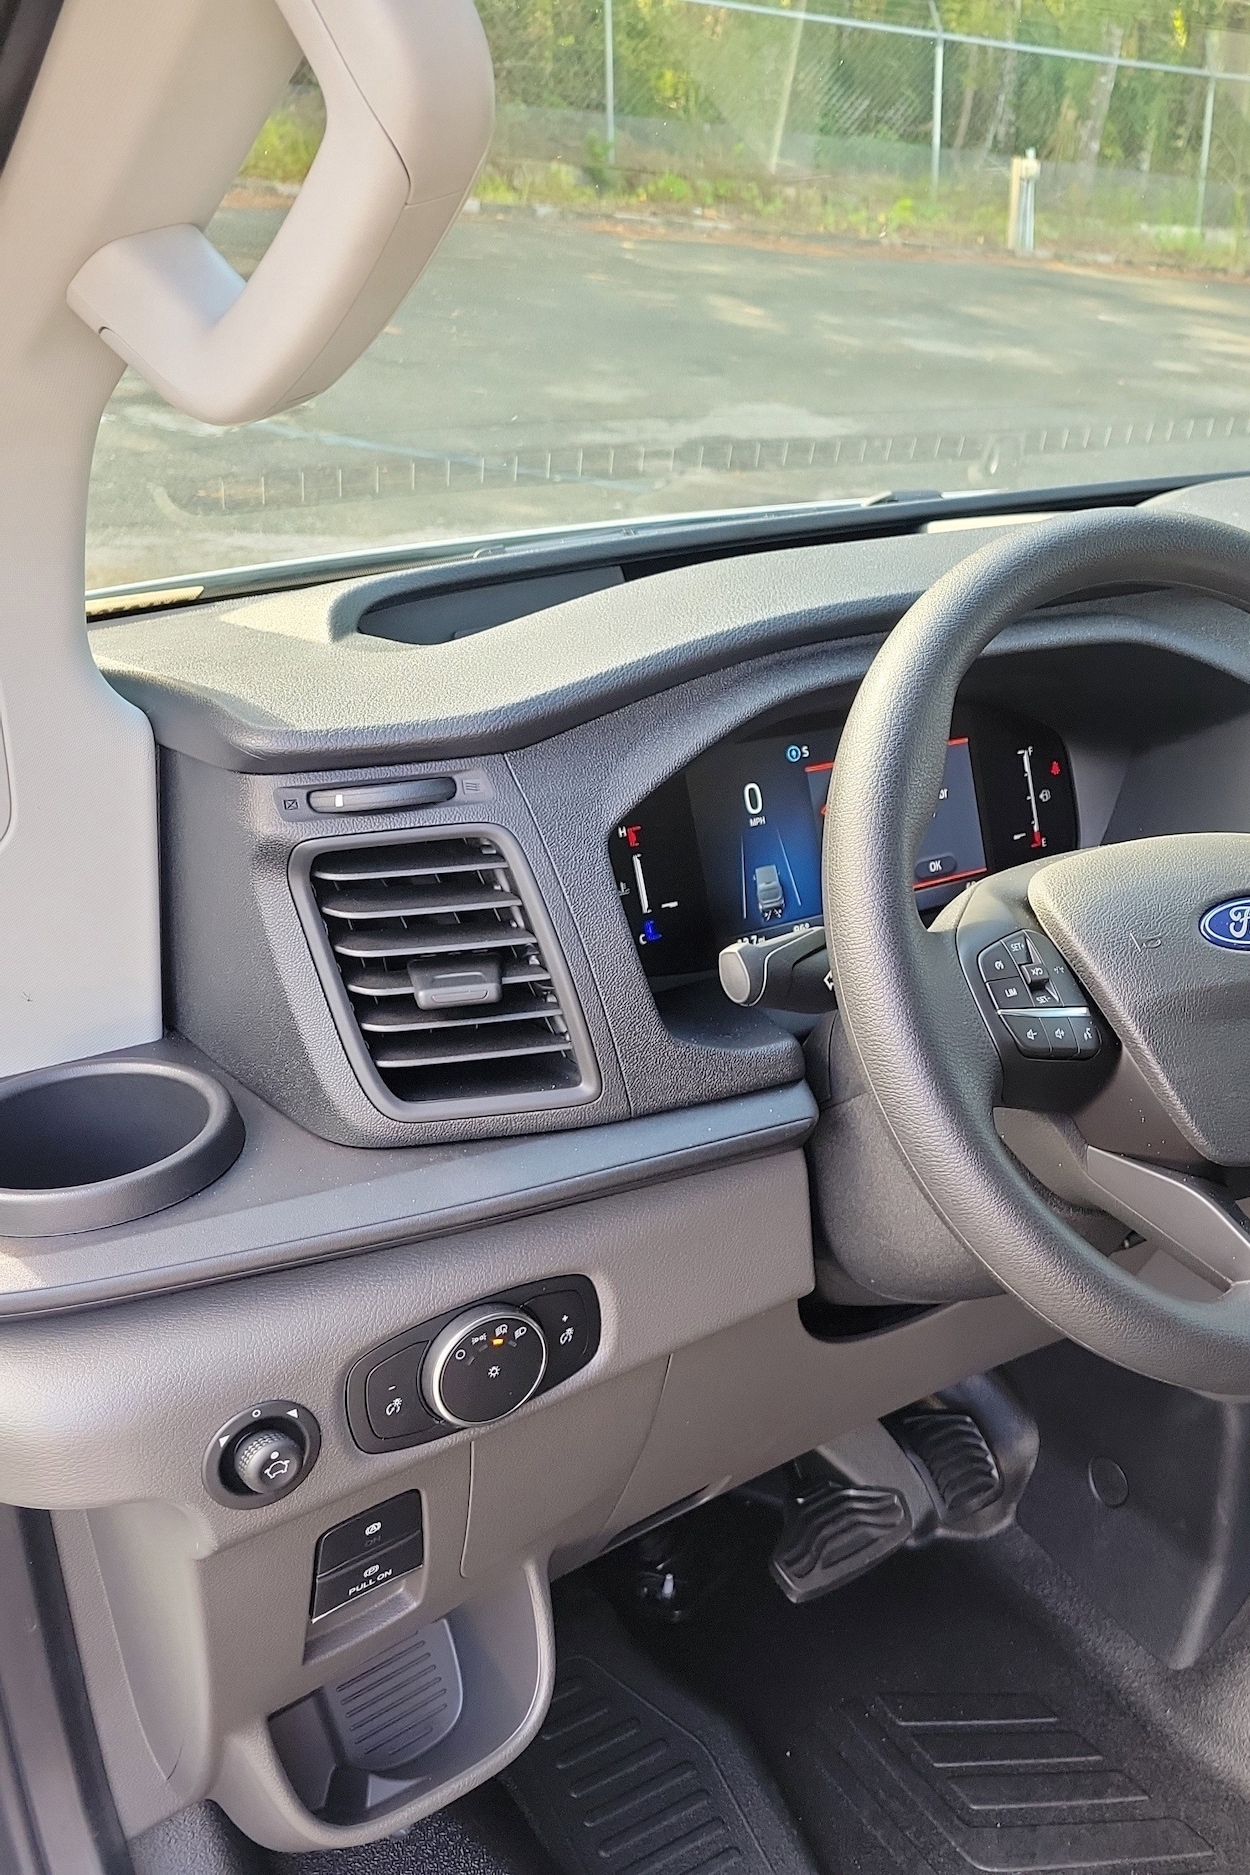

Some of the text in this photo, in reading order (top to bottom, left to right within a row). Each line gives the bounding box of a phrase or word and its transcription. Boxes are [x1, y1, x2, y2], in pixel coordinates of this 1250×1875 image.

[1028, 745, 1034, 757] F
[743, 782, 763, 815] 0
[749, 816, 766, 827] MPH
[618, 825, 627, 839] H
[1041, 837, 1047, 848] E
[928, 859, 942, 873] OK
[639, 933, 647, 945] C
[1010, 942, 1025, 952] SET+
[1004, 987, 1018, 998] LIM
[1036, 995, 1051, 1004] SET-
[348, 1568, 392, 1596] PULL ON
